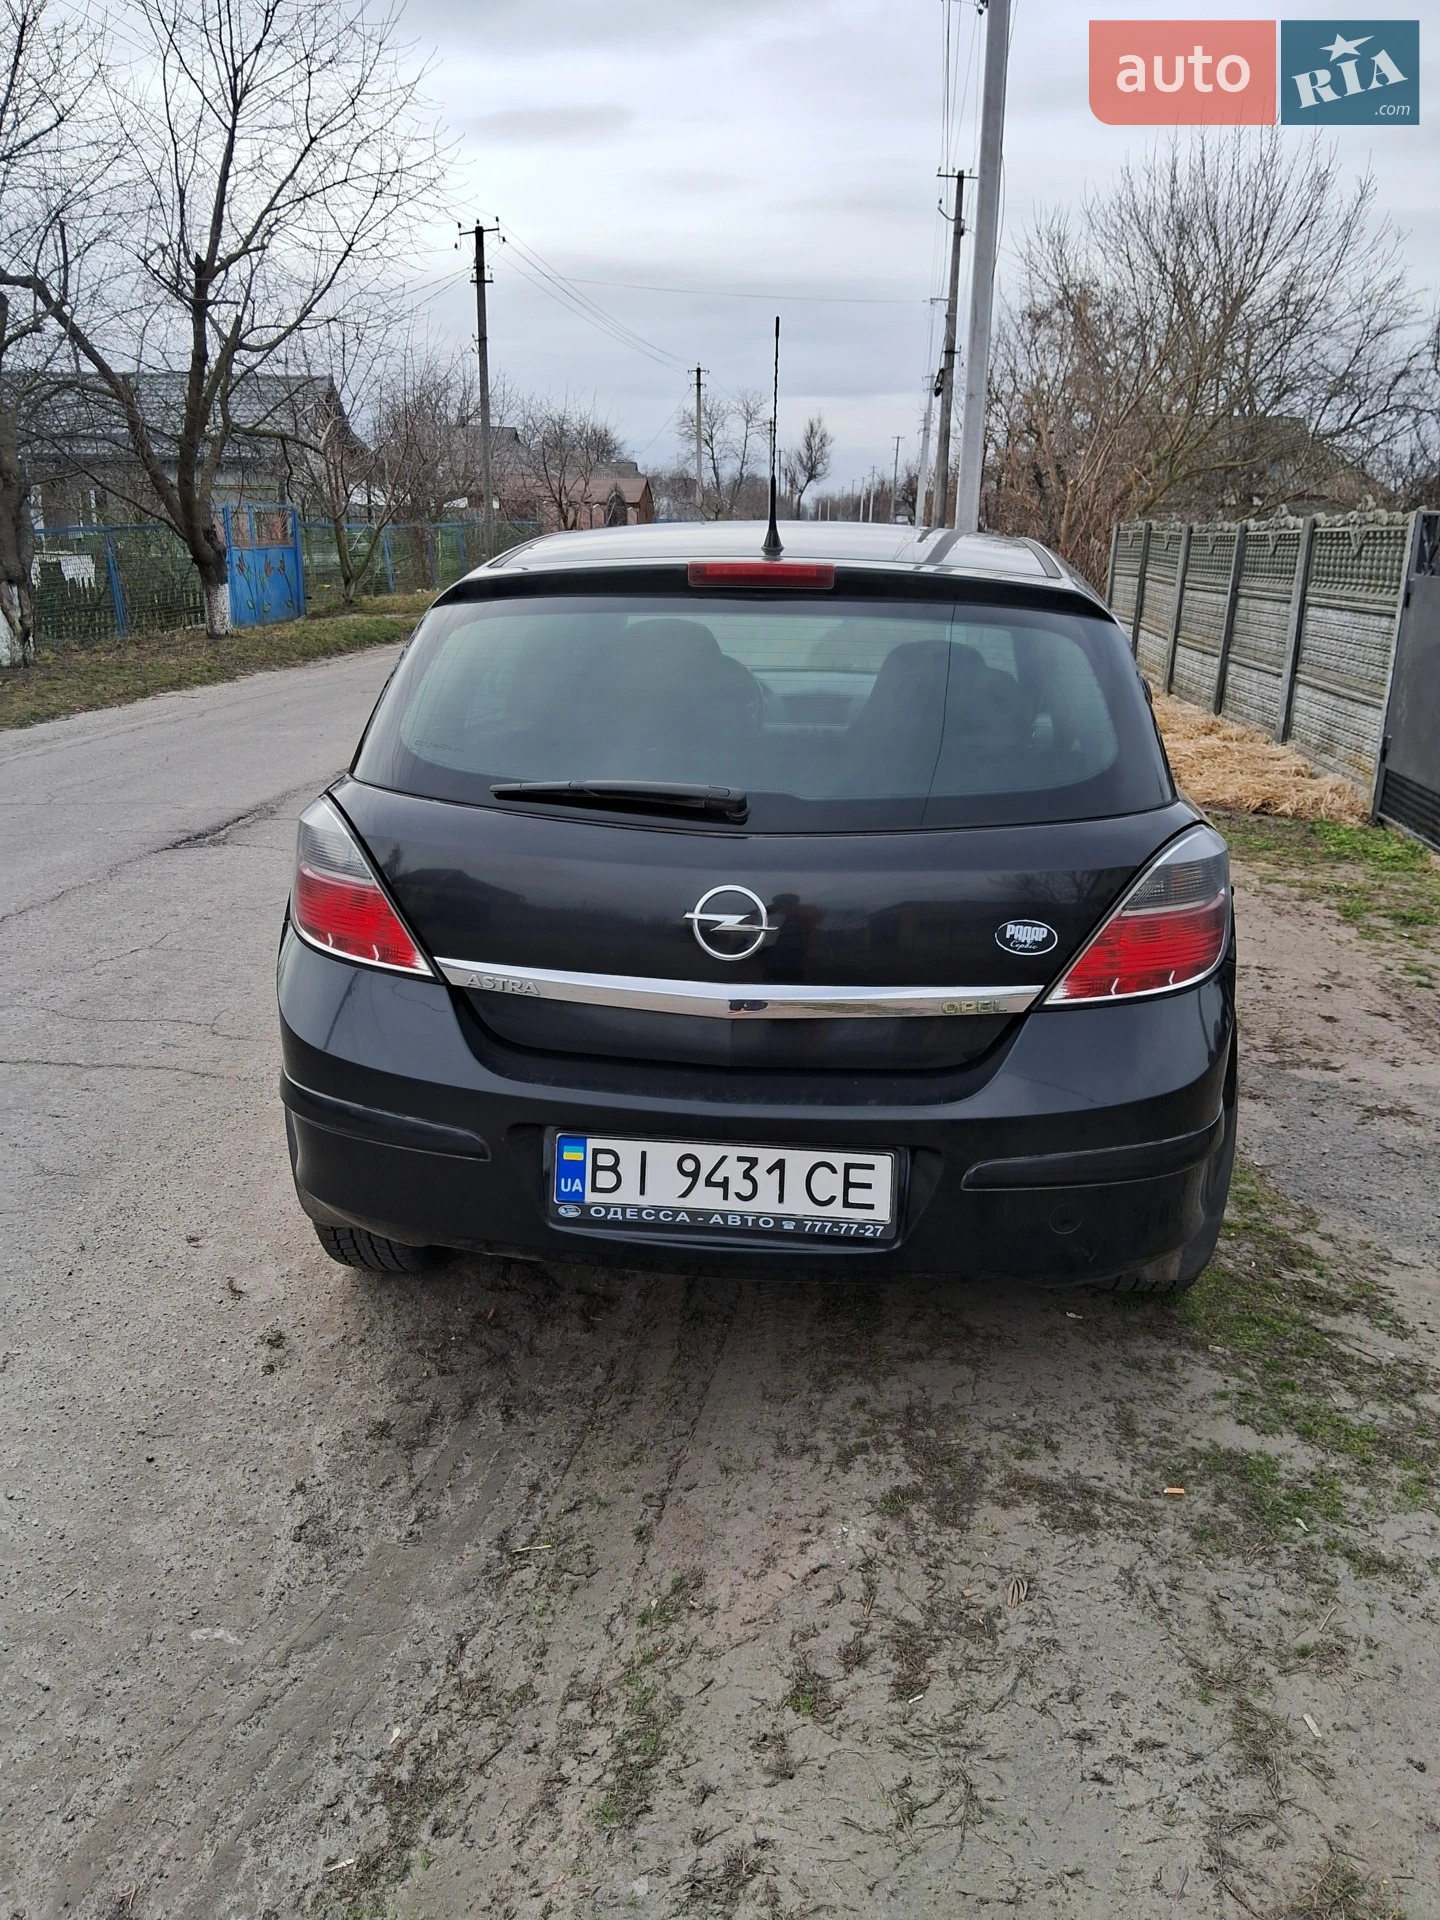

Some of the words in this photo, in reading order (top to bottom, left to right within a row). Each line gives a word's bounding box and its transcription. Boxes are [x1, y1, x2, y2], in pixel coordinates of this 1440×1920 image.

[467, 974, 540, 995] ASTRA
[942, 1000, 1008, 1014] OPEL
[561, 1177, 583, 1193] UA
[590, 1147, 647, 1196] BI
[676, 1152, 786, 1205] 9431
[804, 1160, 876, 1211] CE
[803, 1220, 885, 1237] 777-77-27
